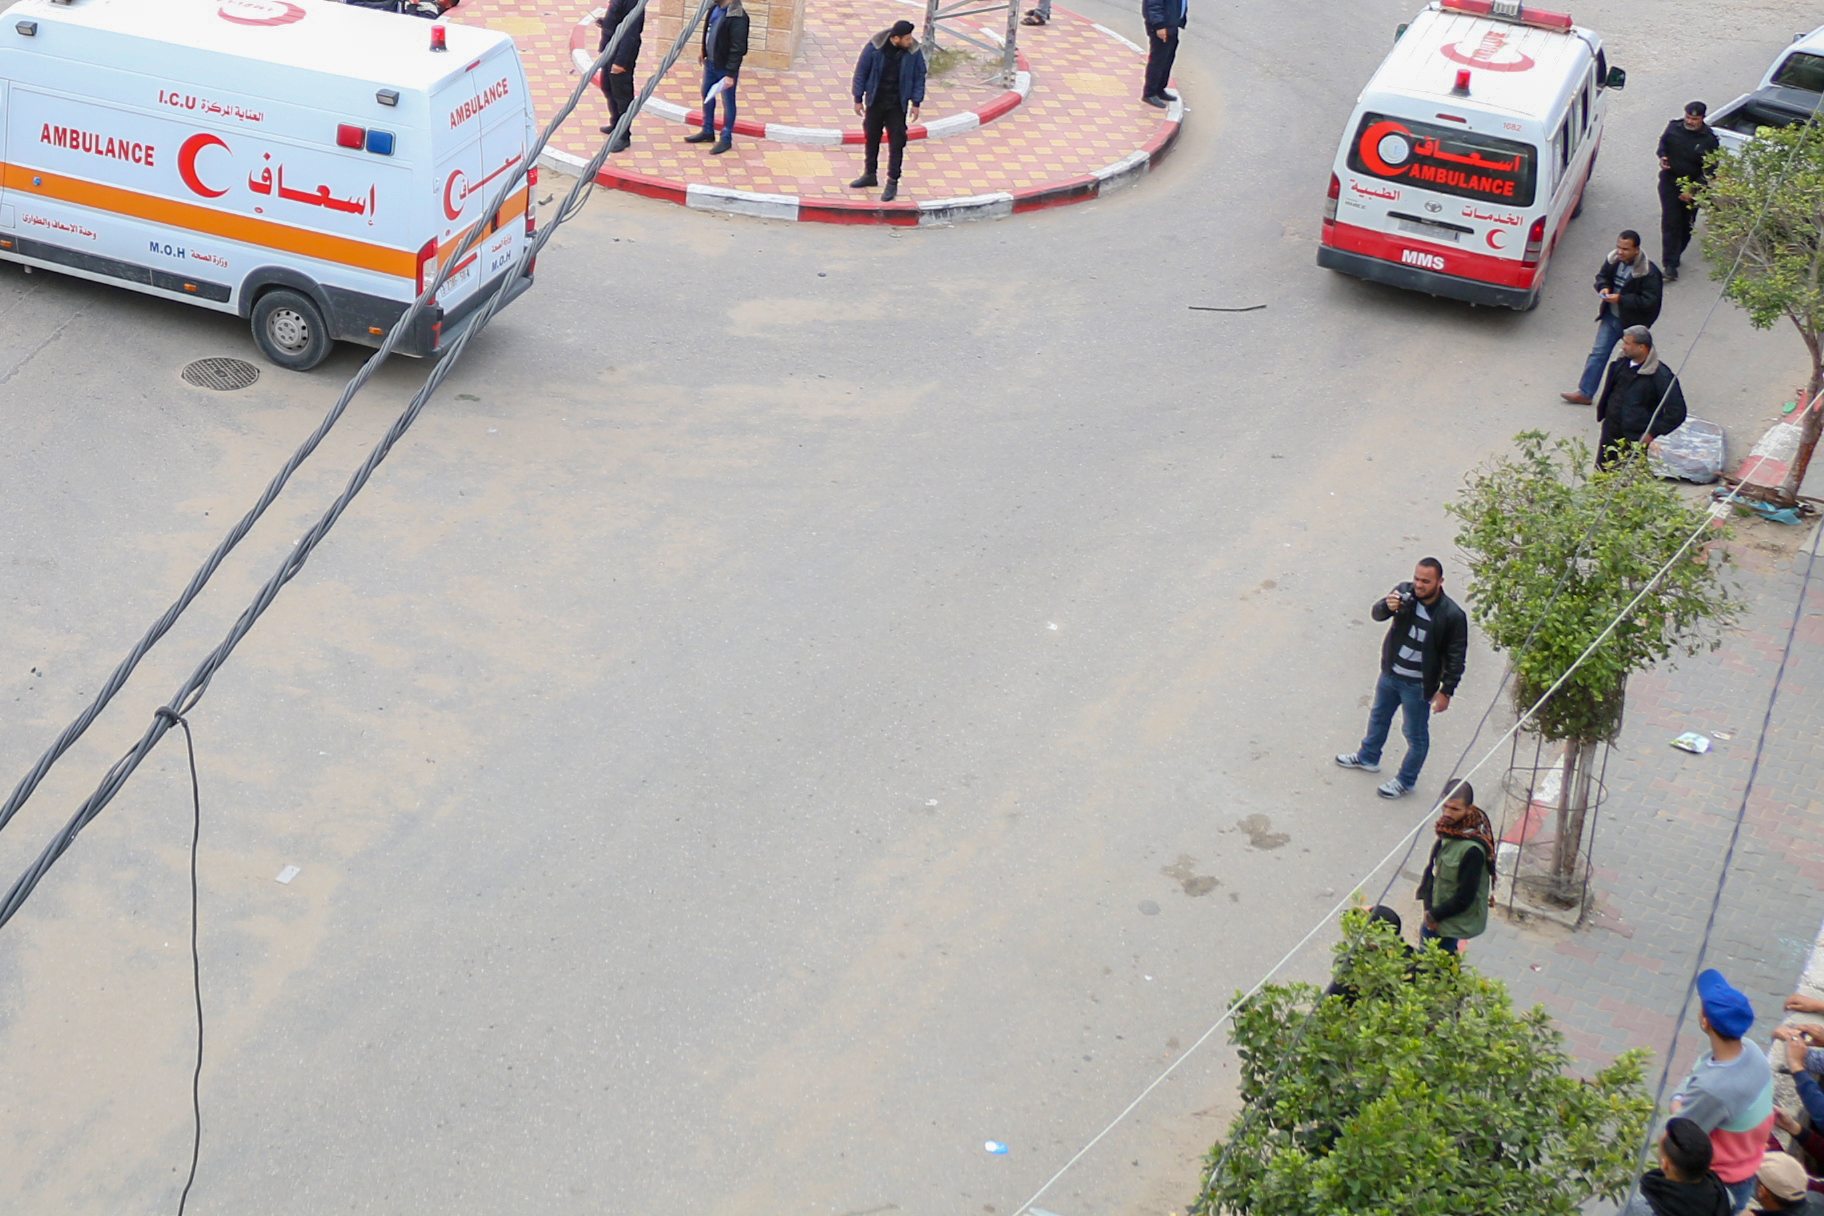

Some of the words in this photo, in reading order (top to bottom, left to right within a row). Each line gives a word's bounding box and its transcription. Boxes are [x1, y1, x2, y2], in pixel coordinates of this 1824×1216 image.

[158, 90, 197, 109] I.C.U
[200, 98, 233, 117] المركزة
[449, 77, 509, 130] AMBULANCE
[234, 106, 264, 122] العناية
[39, 122, 155, 167] AMBULANCE
[246, 150, 376, 226] إسعاف
[1349, 177, 1401, 202] الطبية
[1408, 164, 1516, 197] AMBULANCE
[1461, 204, 1524, 227] الخدمات
[78, 225, 97, 240] وحدة
[149, 241, 186, 259] M.O.H
[190, 249, 213, 263] الصحة
[213, 254, 229, 268] وزارة
[491, 250, 511, 272] M.O.H
[1401, 248, 1445, 272] MMS
